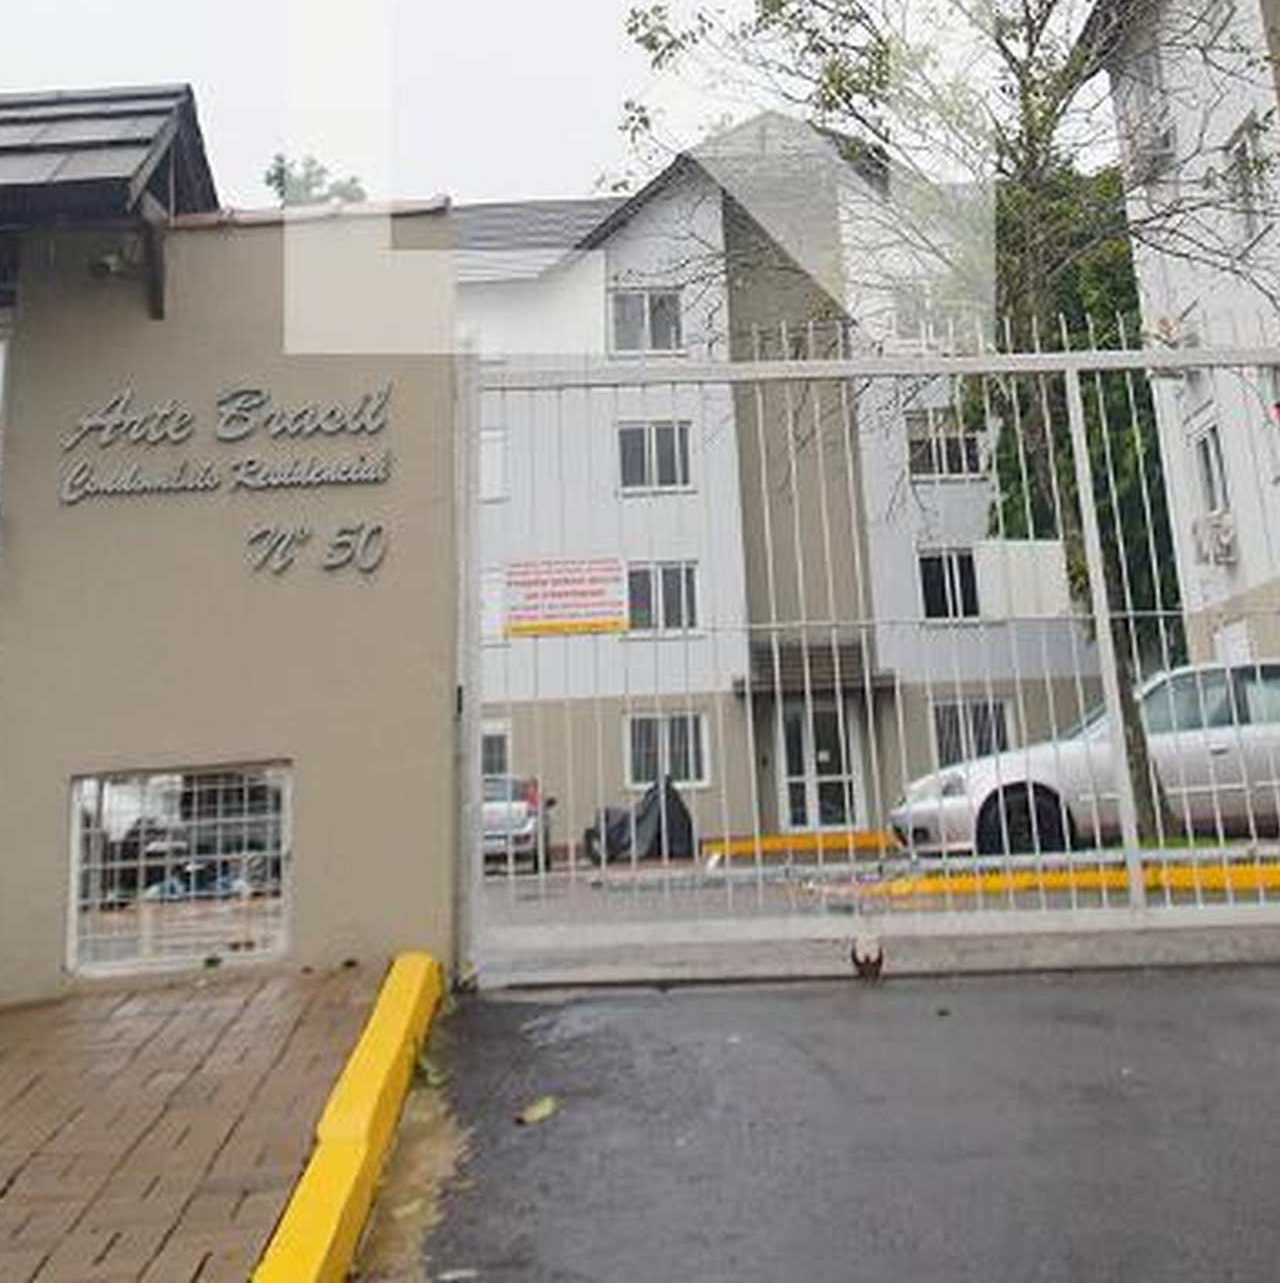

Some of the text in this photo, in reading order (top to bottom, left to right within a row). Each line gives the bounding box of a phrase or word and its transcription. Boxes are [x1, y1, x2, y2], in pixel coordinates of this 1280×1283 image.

[61, 377, 394, 451] Arte Brasil
[230, 454, 391, 491] Residencial
[322, 524, 387, 575] 50
